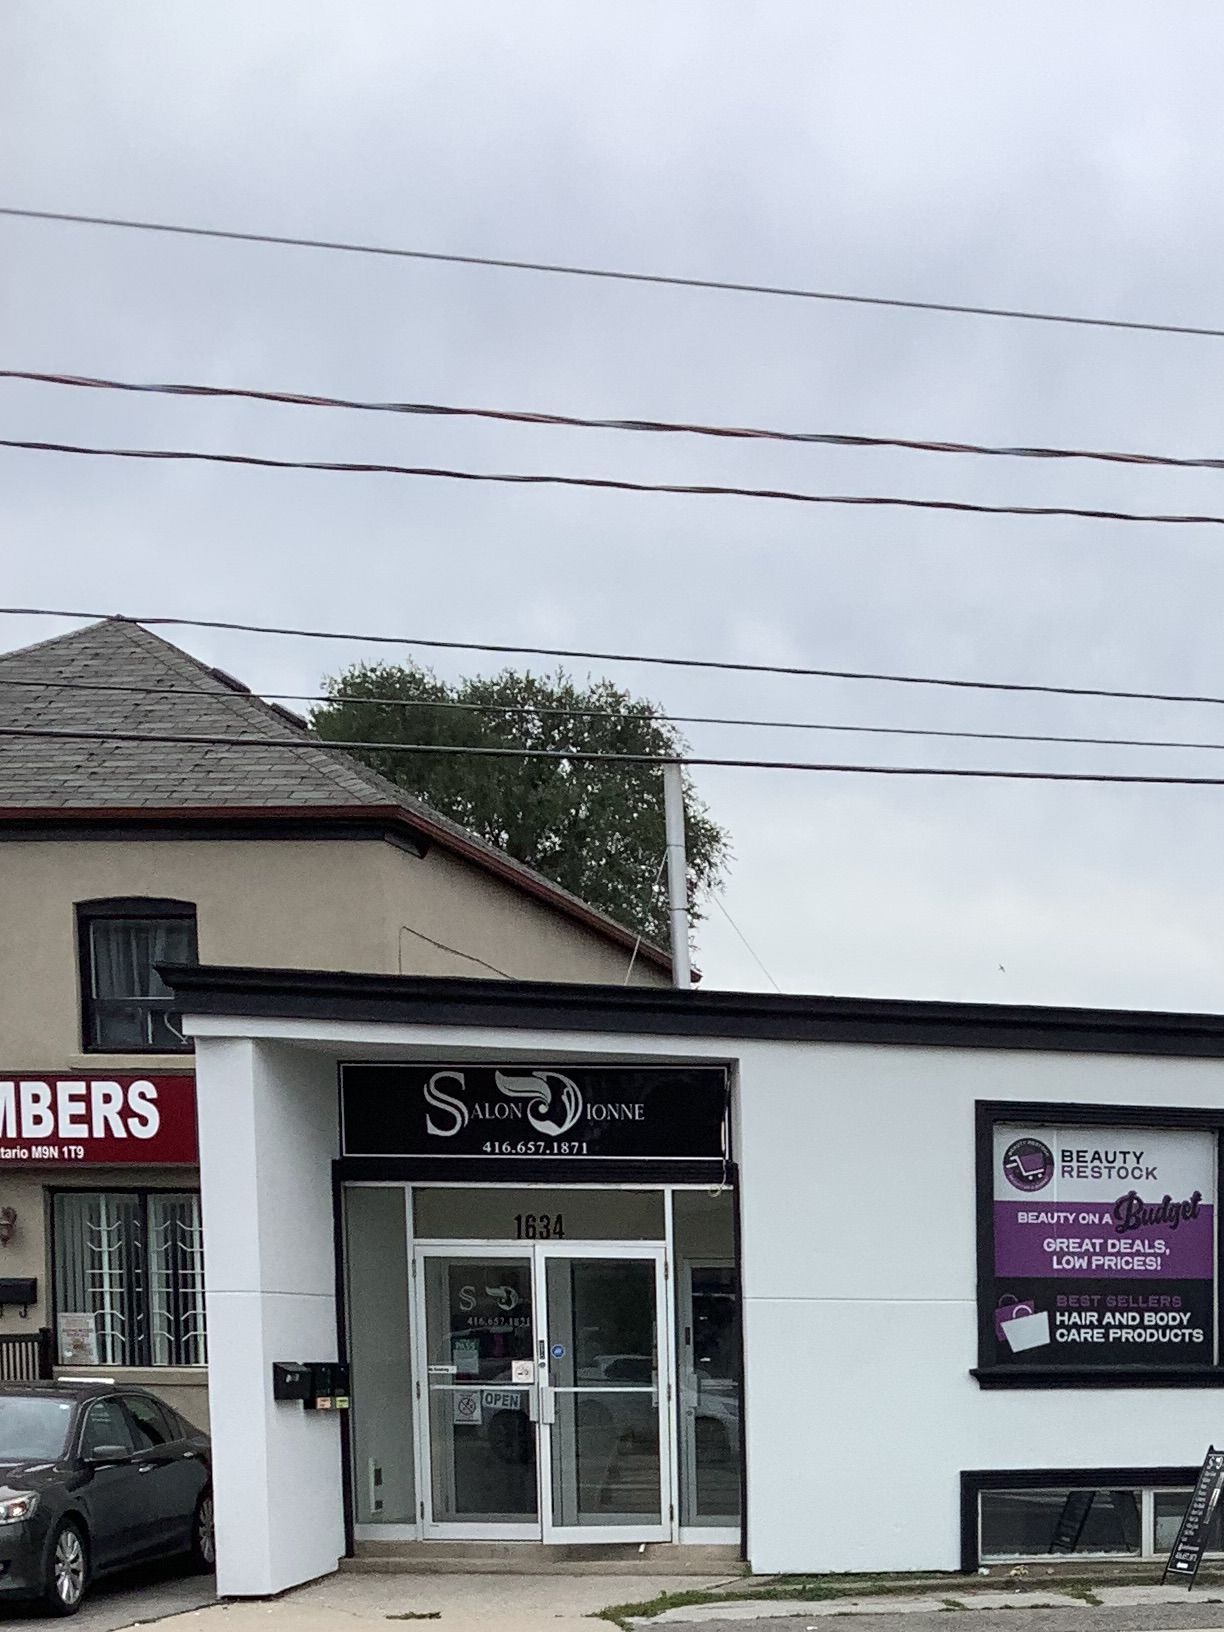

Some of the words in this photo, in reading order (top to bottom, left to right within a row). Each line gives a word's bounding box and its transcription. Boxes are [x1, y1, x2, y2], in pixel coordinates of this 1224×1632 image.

[31, 1146, 59, 1159] M9N
[62, 1146, 85, 1159] 1T9
[482, 1140, 588, 1154] 416.657.1871
[1061, 1150, 1144, 1164] BEAUTY
[1061, 1165, 1158, 1180] RESTOCK
[1017, 1212, 1076, 1224] BEAUTY
[1079, 1212, 1099, 1224] ON
[1102, 1213, 1113, 1225] A
[1114, 1190, 1202, 1234] Budget
[513, 1214, 565, 1240] 1634
[1043, 1238, 1104, 1252] GREAT
[1107, 1239, 1170, 1255] DEALS,
[1052, 1256, 1088, 1270] LOW
[1091, 1256, 1162, 1270] PRICES!
[1056, 1295, 1101, 1307] BEST
[1106, 1295, 1182, 1307] SELLERS
[1055, 1312, 1099, 1325] HAIR
[1102, 1312, 1140, 1326] AND
[1144, 1312, 1191, 1326] BODY
[1055, 1329, 1105, 1342] CARE
[1109, 1329, 1204, 1342] PRODUCTS
[485, 1392, 519, 1407] OPEN
